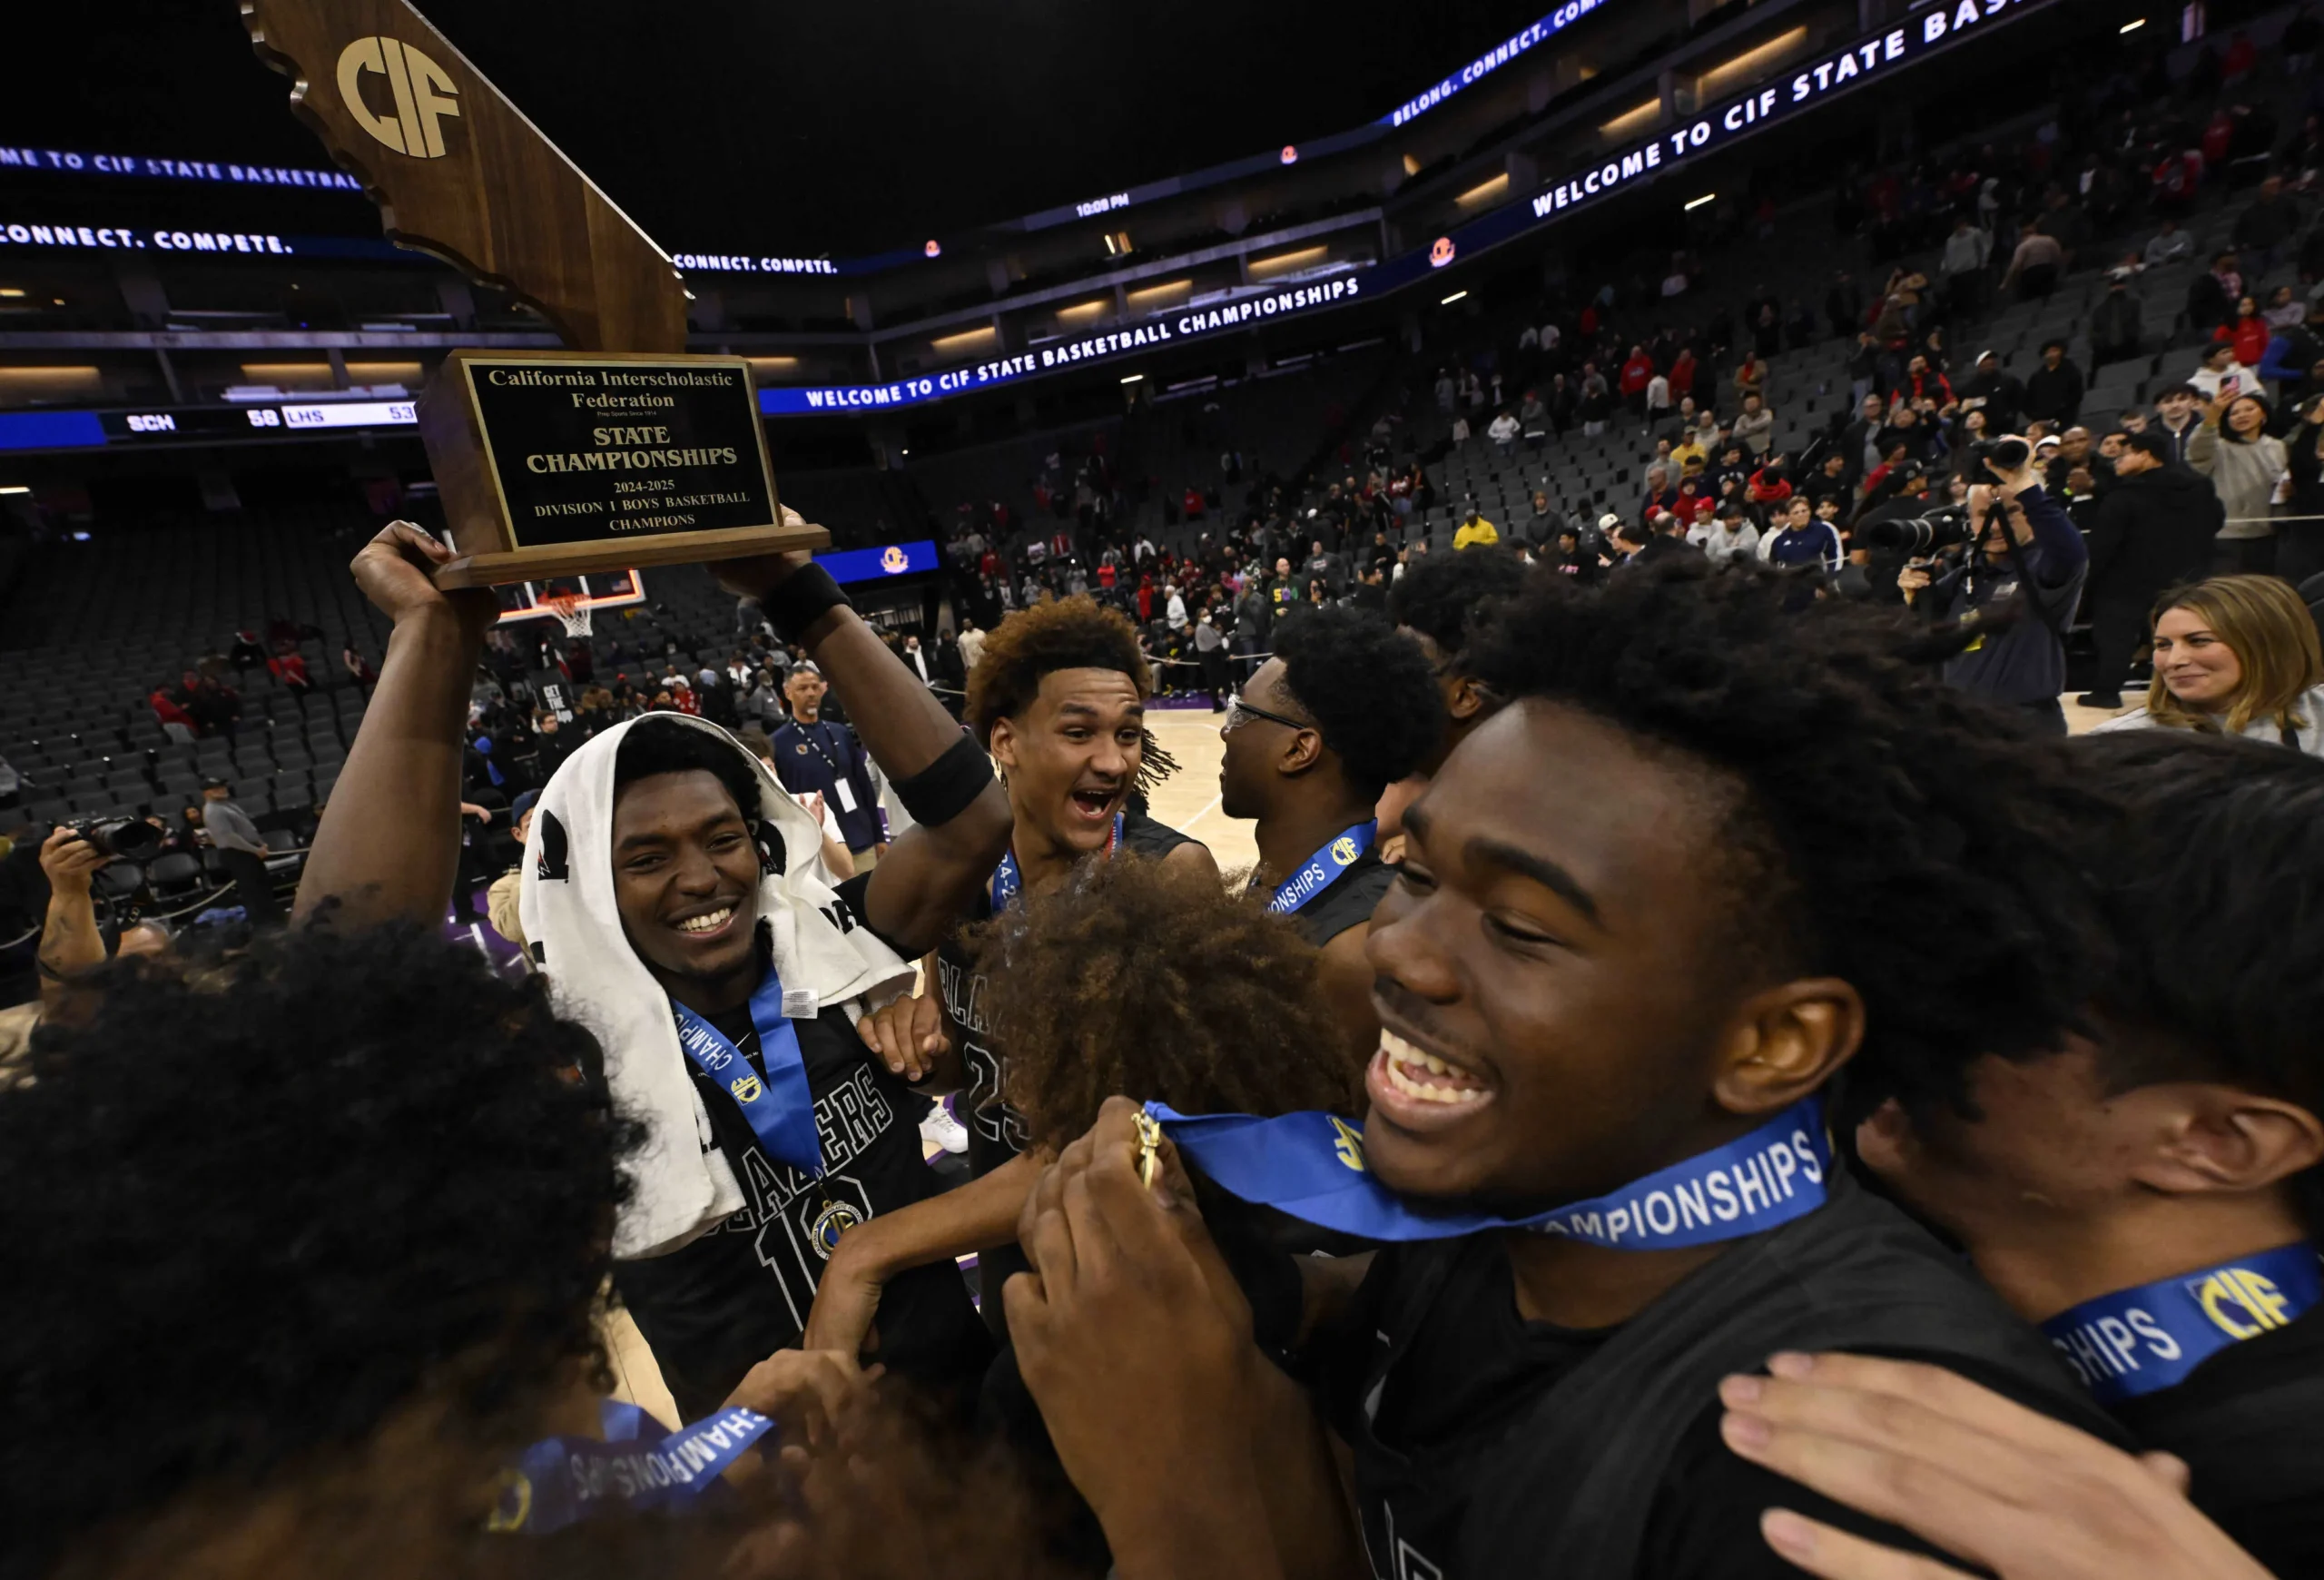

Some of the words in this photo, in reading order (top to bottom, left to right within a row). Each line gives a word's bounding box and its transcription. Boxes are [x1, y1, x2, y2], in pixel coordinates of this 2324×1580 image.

[1393, 80, 1458, 127] BELONG.
[1462, 23, 1547, 84] CONNECT.
[1553, 0, 1603, 28] COM
[337, 36, 459, 159] CIF
[1532, 142, 1661, 217] WELCOME
[1670, 121, 1711, 155] TO
[1724, 89, 1776, 131] CIF
[1792, 29, 1905, 102] STATE
[1924, 0, 2022, 43] BAS
[46, 151, 84, 170] TO
[94, 154, 135, 173] CIF
[145, 159, 222, 180] STATE
[1110, 192, 1129, 209] PM
[153, 231, 293, 254] COMPETE.
[673, 253, 757, 271] CONNECT.
[761, 258, 838, 274] COMPETE.
[806, 386, 901, 407] WELCOME
[907, 379, 932, 398] TO
[939, 369, 970, 390] CIF
[977, 353, 1036, 381] STATE
[1042, 323, 1171, 367] BASKETBALL
[1178, 277, 1359, 334] CHAMPIONSHIPS
[488, 370, 596, 387] California
[602, 371, 733, 387] Interscholastic
[570, 392, 675, 408] Federation
[127, 414, 176, 432] SCH
[247, 410, 280, 427] 58
[286, 410, 324, 424] LHS
[389, 406, 414, 419] 53
[593, 426, 671, 446] STATE
[527, 447, 738, 474] CHAMPIONSHIPS
[613, 479, 675, 494] 2024-2025
[535, 501, 603, 517] DIVISION
[623, 498, 660, 511] BOYS
[665, 491, 751, 509] BASKETBALL
[609, 514, 696, 531] CHAMPIONS
[543, 684, 560, 698] GET
[547, 696, 566, 711] THE
[1332, 836, 1356, 865] CIF
[938, 956, 1006, 1041] BLA
[730, 1076, 762, 1102] CIF
[1527, 1130, 1823, 1243] AMPIONSHIPS
[2201, 1268, 2290, 1340] CIF
